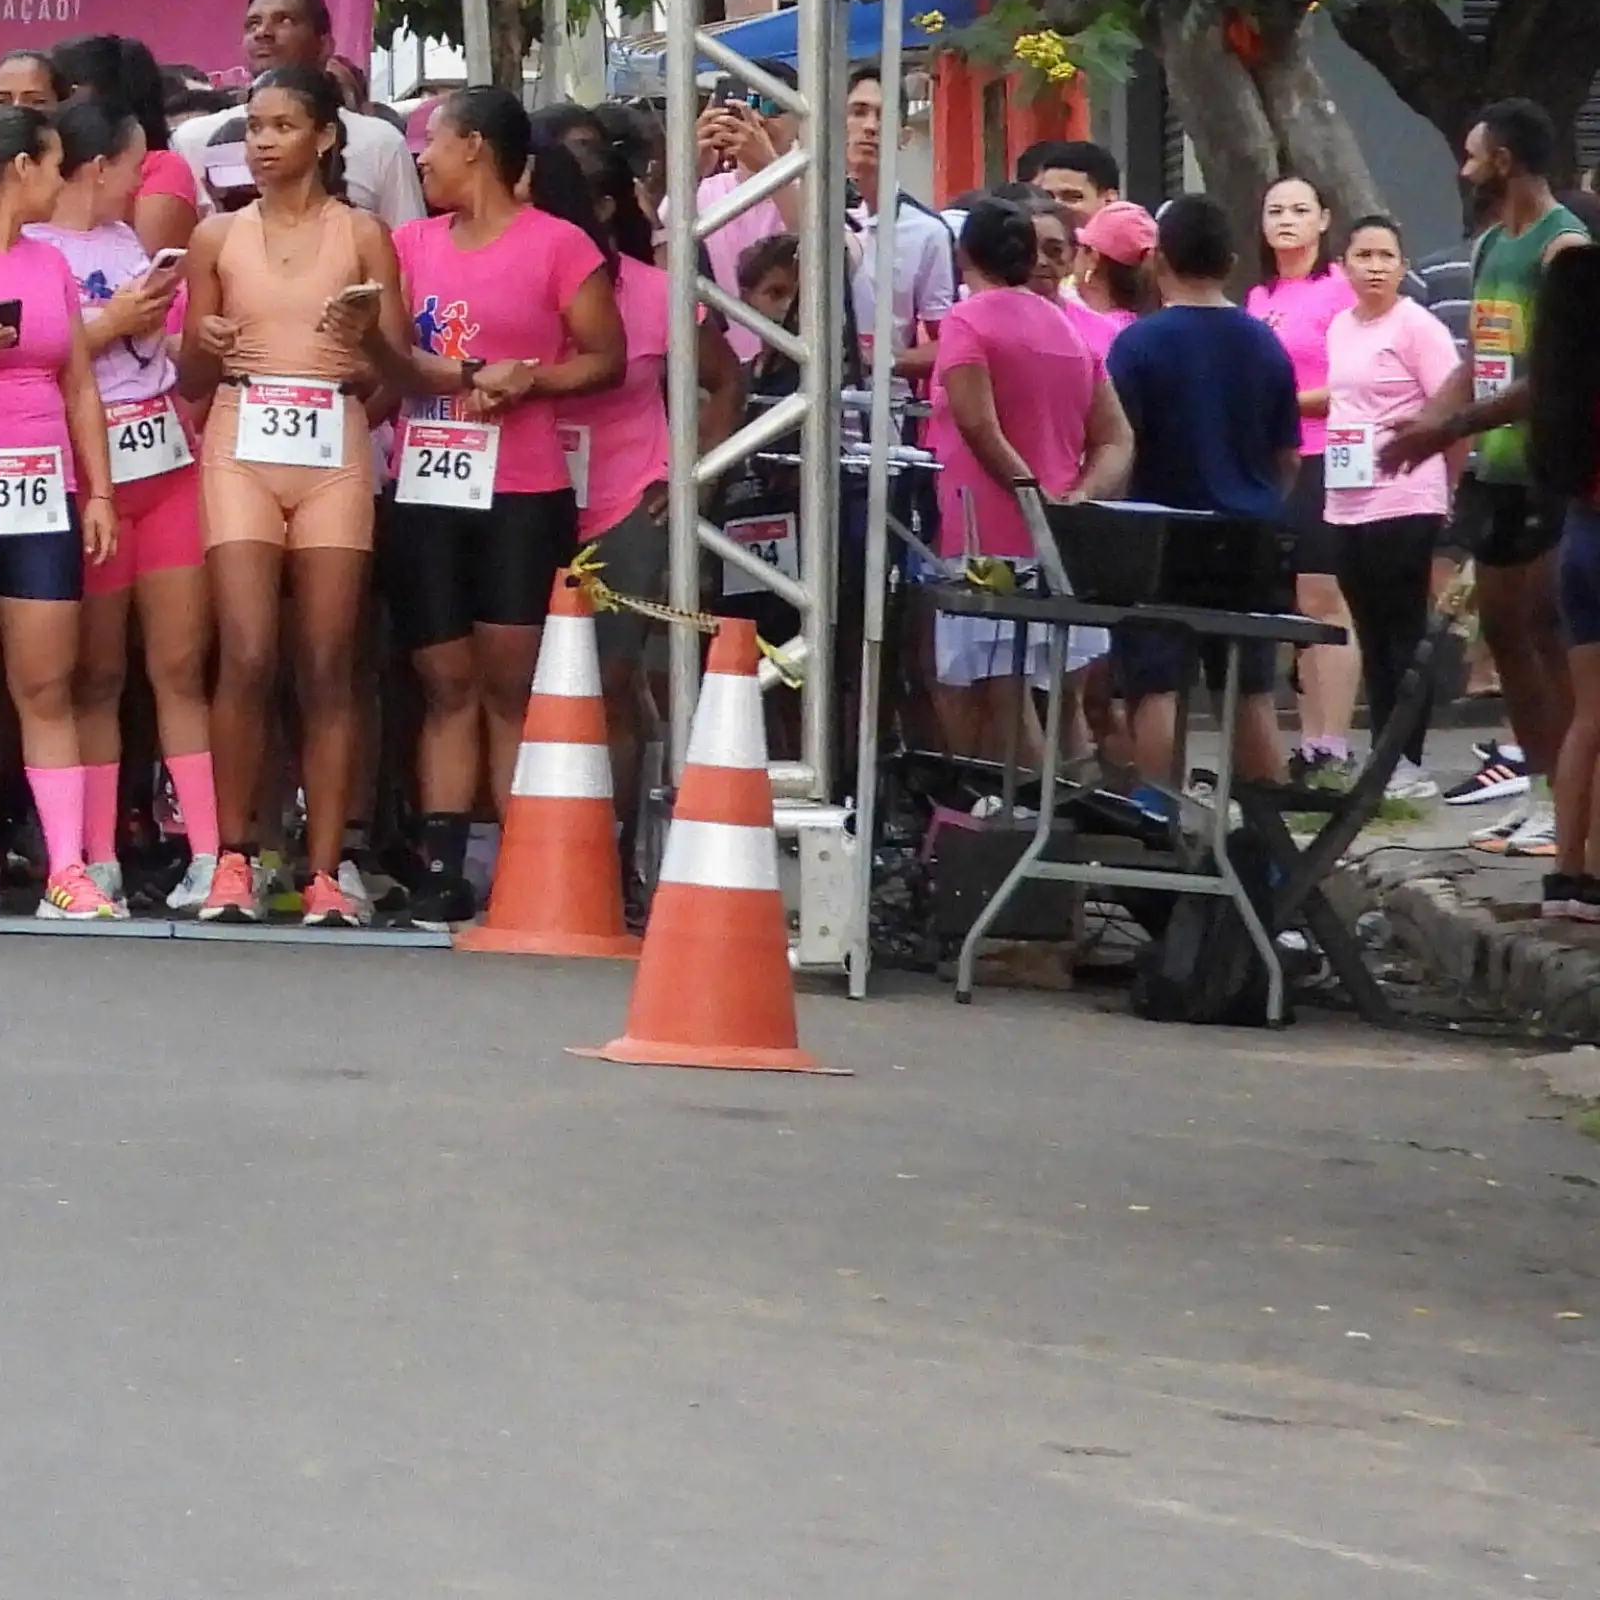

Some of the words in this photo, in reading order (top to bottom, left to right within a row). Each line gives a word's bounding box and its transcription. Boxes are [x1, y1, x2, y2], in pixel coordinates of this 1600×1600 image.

[118, 416, 167, 452] 497
[261, 406, 319, 439] 331
[415, 449, 473, 481] 246
